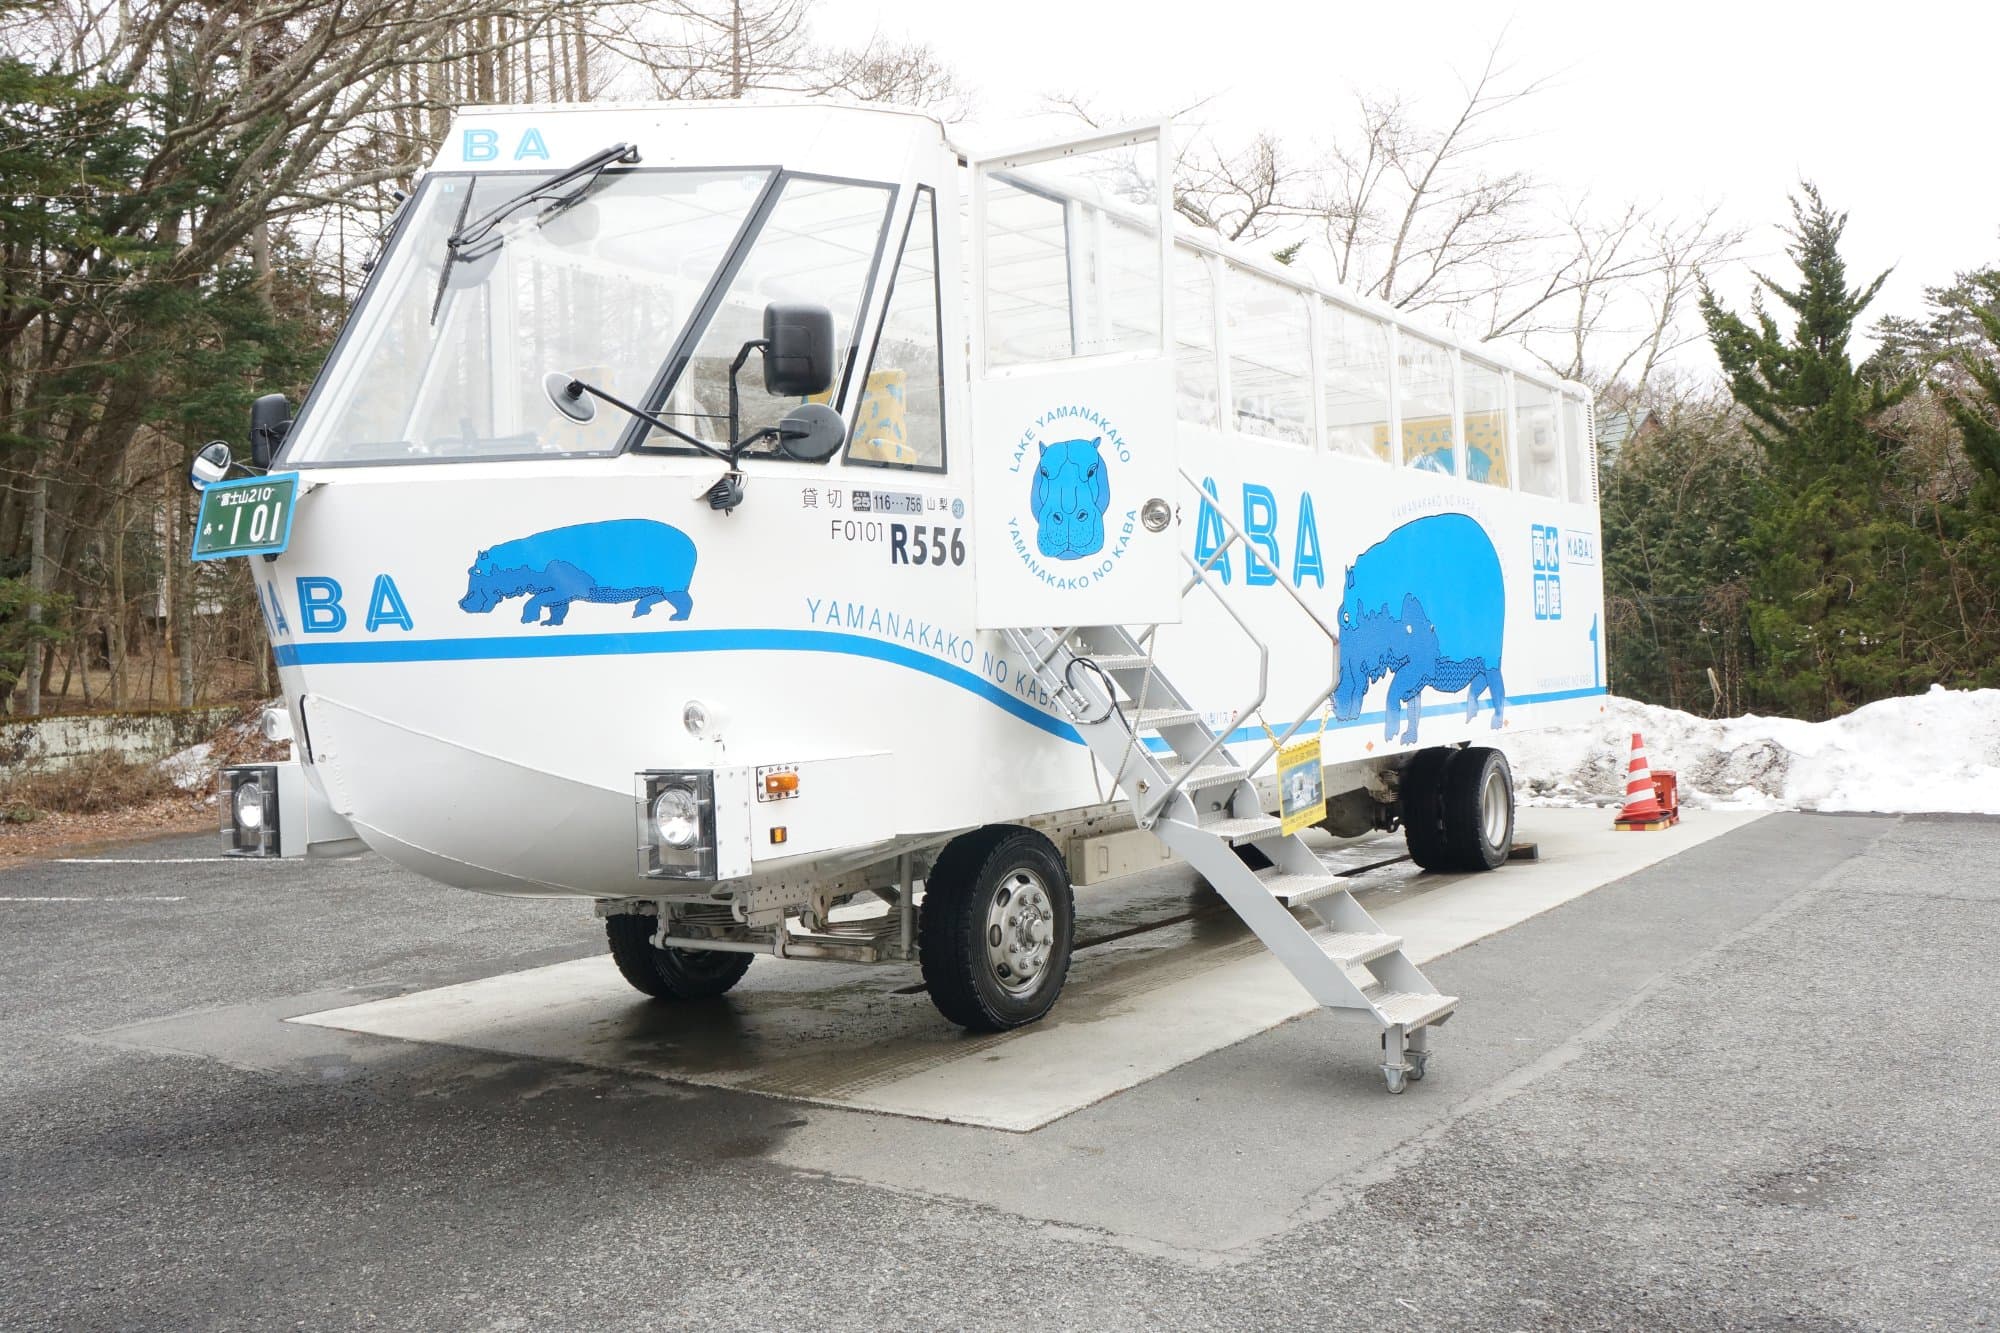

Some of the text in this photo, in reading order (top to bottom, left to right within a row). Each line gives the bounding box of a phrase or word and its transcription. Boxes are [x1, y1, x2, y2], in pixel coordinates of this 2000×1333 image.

[462, 127, 550, 162] BA
[1009, 405, 1131, 473] LAKE YAMANAKAKO
[801, 487, 843, 509] 貸切
[926, 497, 948, 511] 山梨
[890, 523, 966, 567] R556
[1008, 509, 1137, 590] YAMANAKAKO NO KABA
[806, 597, 974, 664] YAMANAKAKO
[982, 651, 1008, 683] NO
